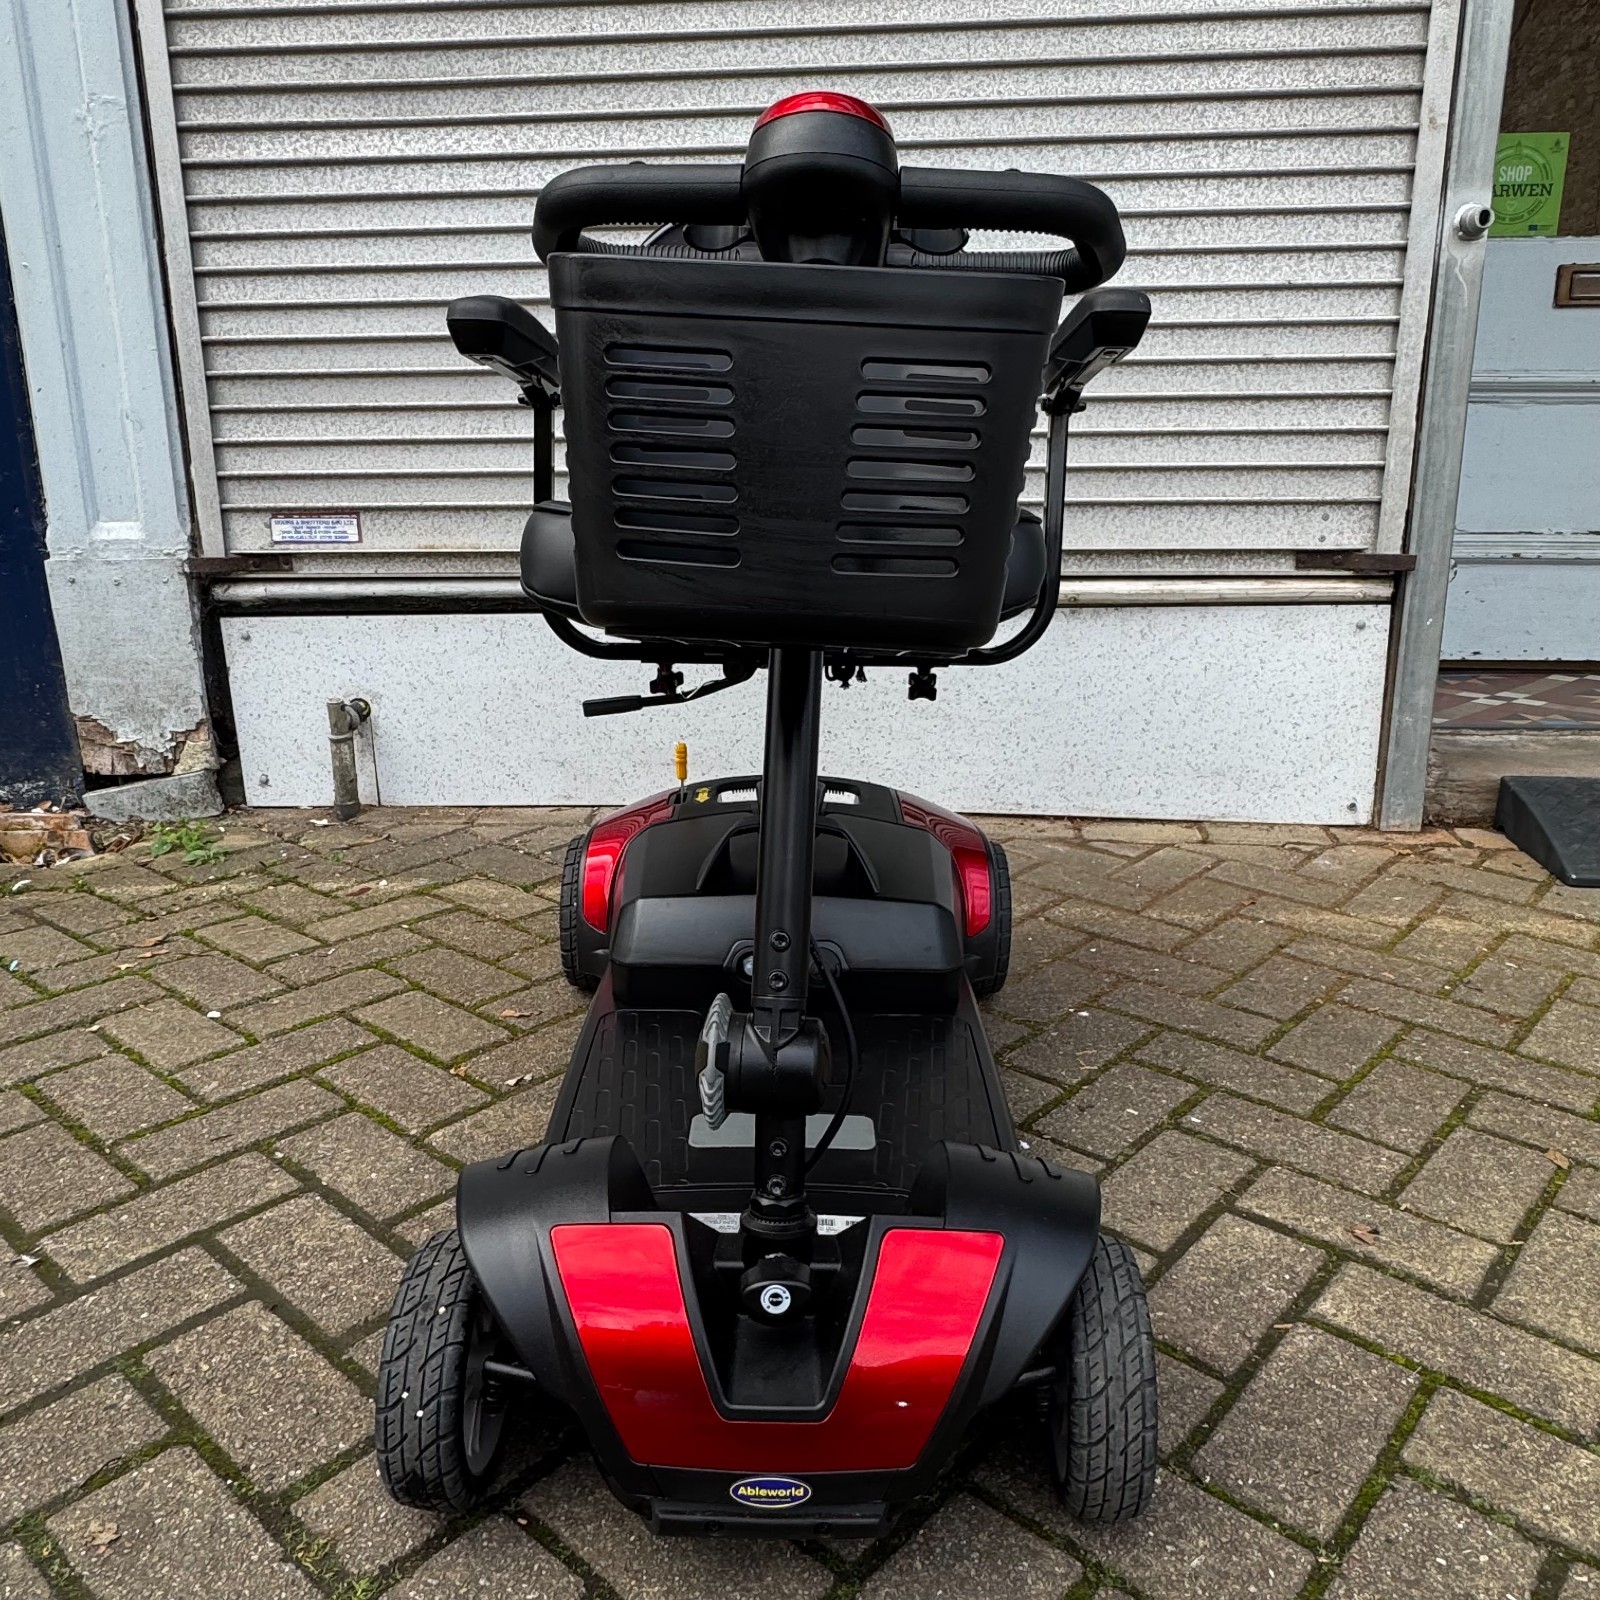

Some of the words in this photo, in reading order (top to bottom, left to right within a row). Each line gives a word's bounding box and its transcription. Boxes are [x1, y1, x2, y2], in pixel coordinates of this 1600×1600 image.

[1499, 166, 1533, 182] SHOP
[1492, 183, 1554, 197] ARWEN
[738, 1486, 804, 1497] Ableworld
